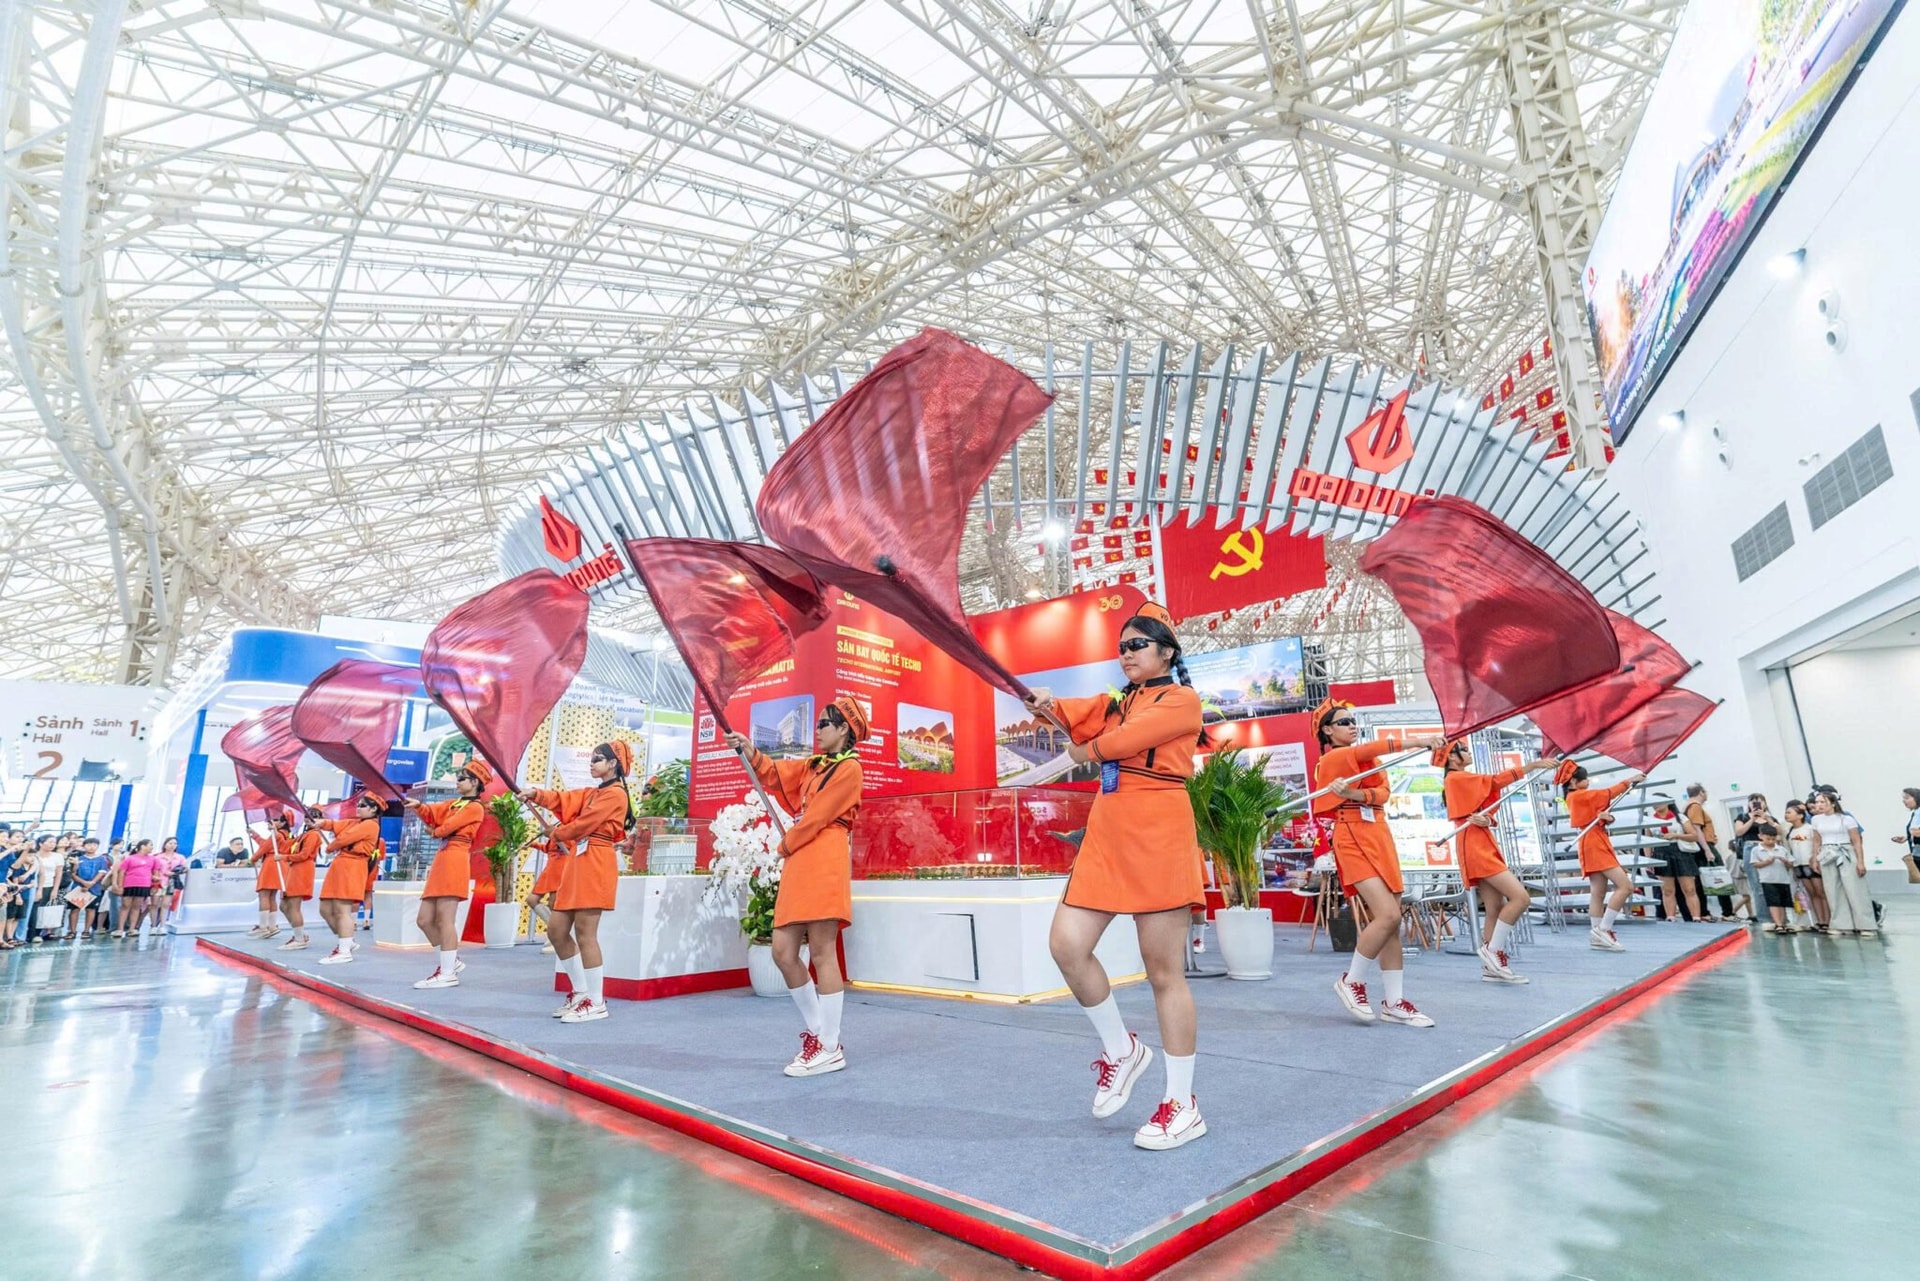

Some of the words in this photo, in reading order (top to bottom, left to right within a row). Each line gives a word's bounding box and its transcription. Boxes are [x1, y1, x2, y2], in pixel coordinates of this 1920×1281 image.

[1288, 468, 1434, 518] DAIDUN
[36, 716, 84, 730] Sảnh
[93, 718, 122, 728] Sảnh
[130, 720, 139, 737] 1
[32, 733, 62, 744] Hall
[700, 731, 713, 742] NSW
[34, 750, 63, 780] 2
